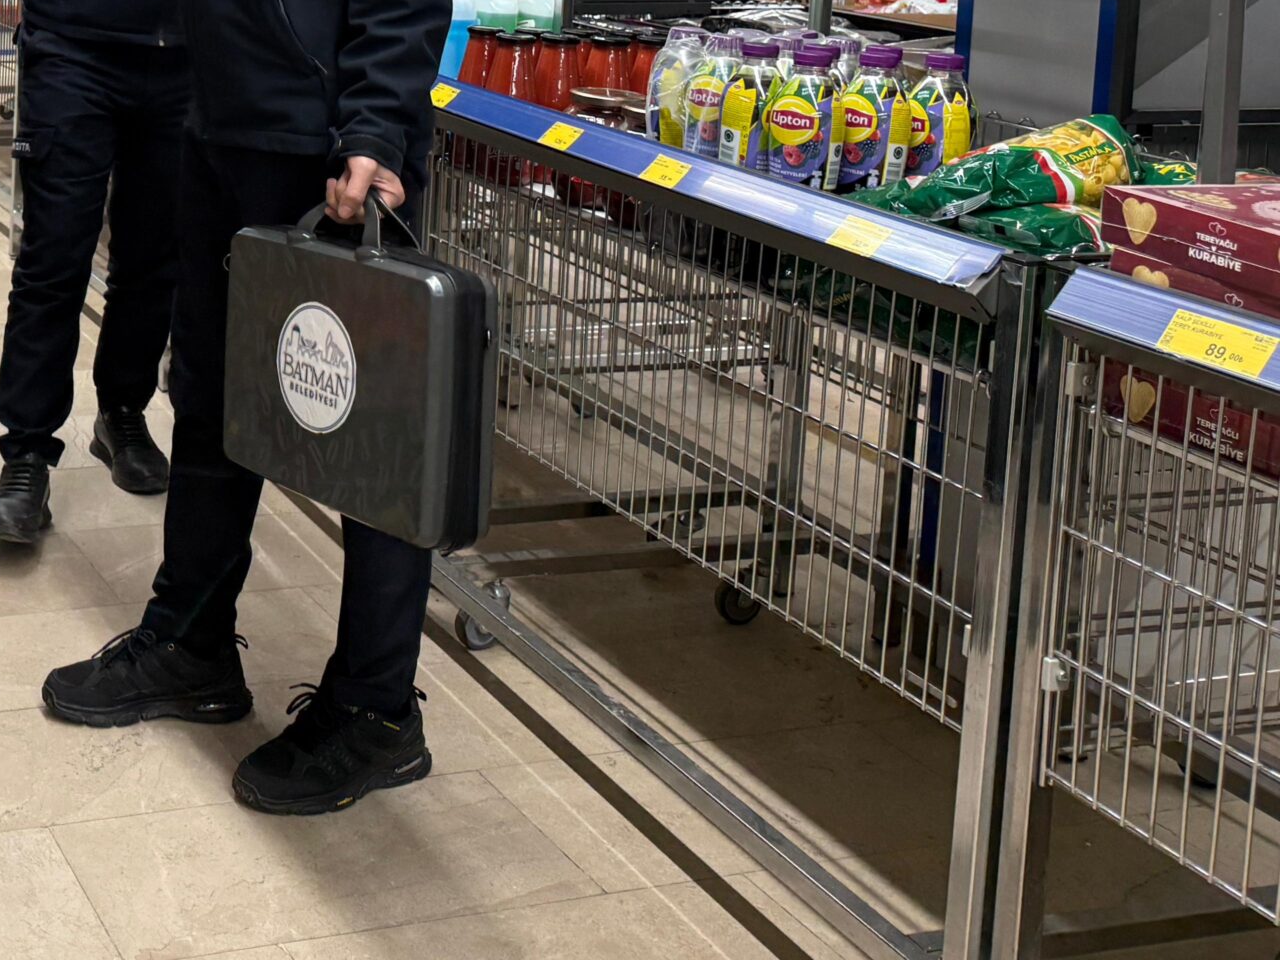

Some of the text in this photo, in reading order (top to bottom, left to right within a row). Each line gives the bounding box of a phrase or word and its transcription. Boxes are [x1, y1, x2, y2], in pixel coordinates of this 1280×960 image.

[771, 111, 811, 129] Lipton
[1195, 230, 1238, 251] TEREYAĞLI
[1188, 247, 1242, 273] KURABİYE
[282, 352, 349, 401] BATMAN
[289, 382, 338, 410] BELEDİYESİ
